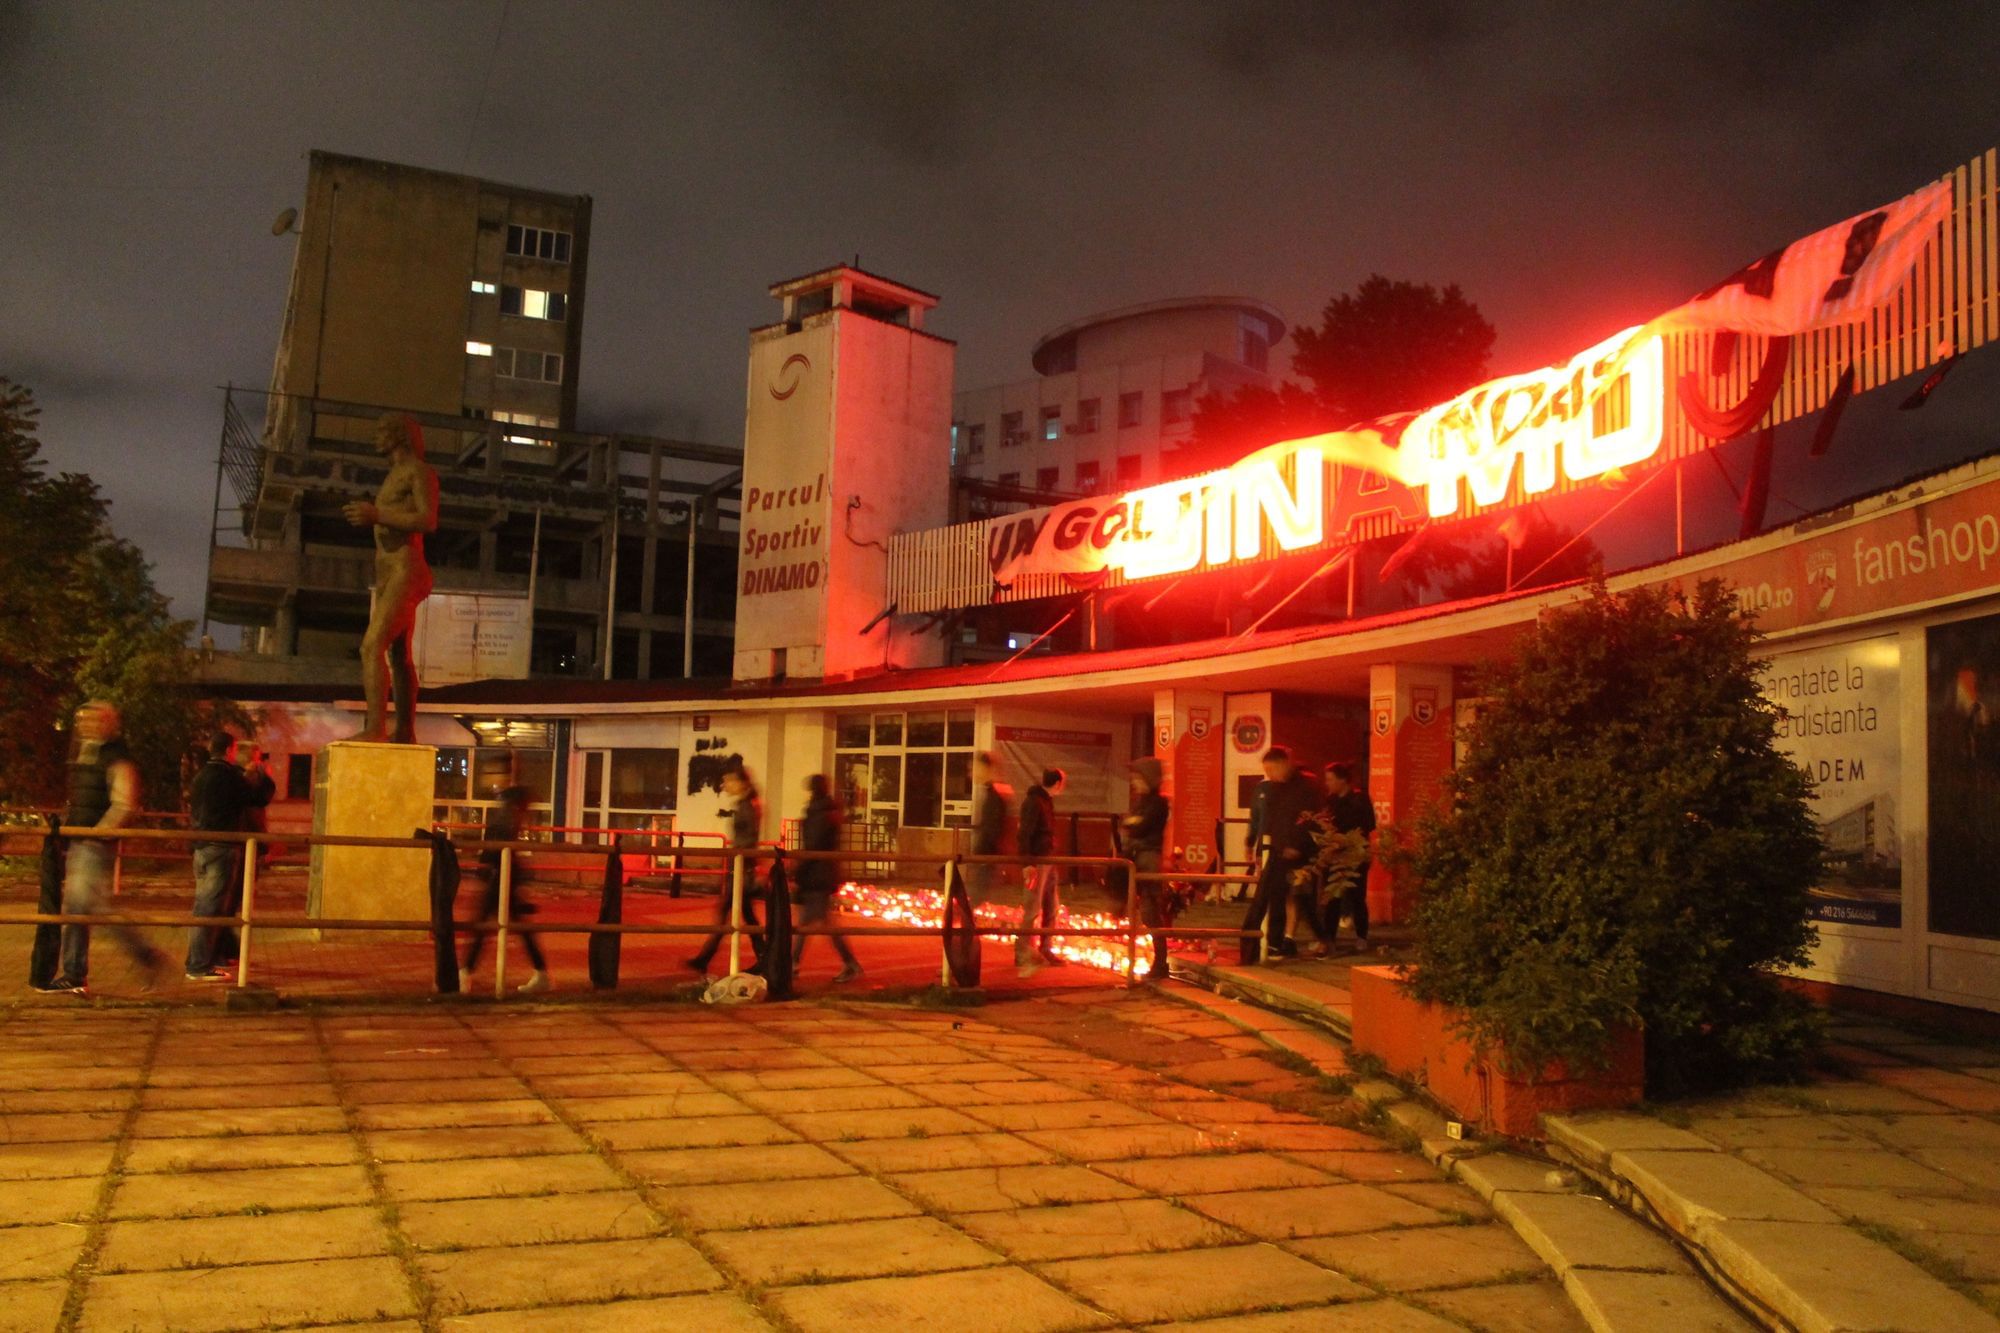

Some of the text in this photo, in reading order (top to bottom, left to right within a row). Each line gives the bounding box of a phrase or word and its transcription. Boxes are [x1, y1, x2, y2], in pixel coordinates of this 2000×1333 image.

[746, 473, 825, 514] Parcul
[744, 518, 822, 561] Sportiv
[742, 560, 820, 597] DINAMO
[1845, 656, 1864, 691] la
[1794, 700, 1878, 738] distanta
[1804, 758, 1865, 783] ADEM
[1185, 844, 1209, 864] 65
